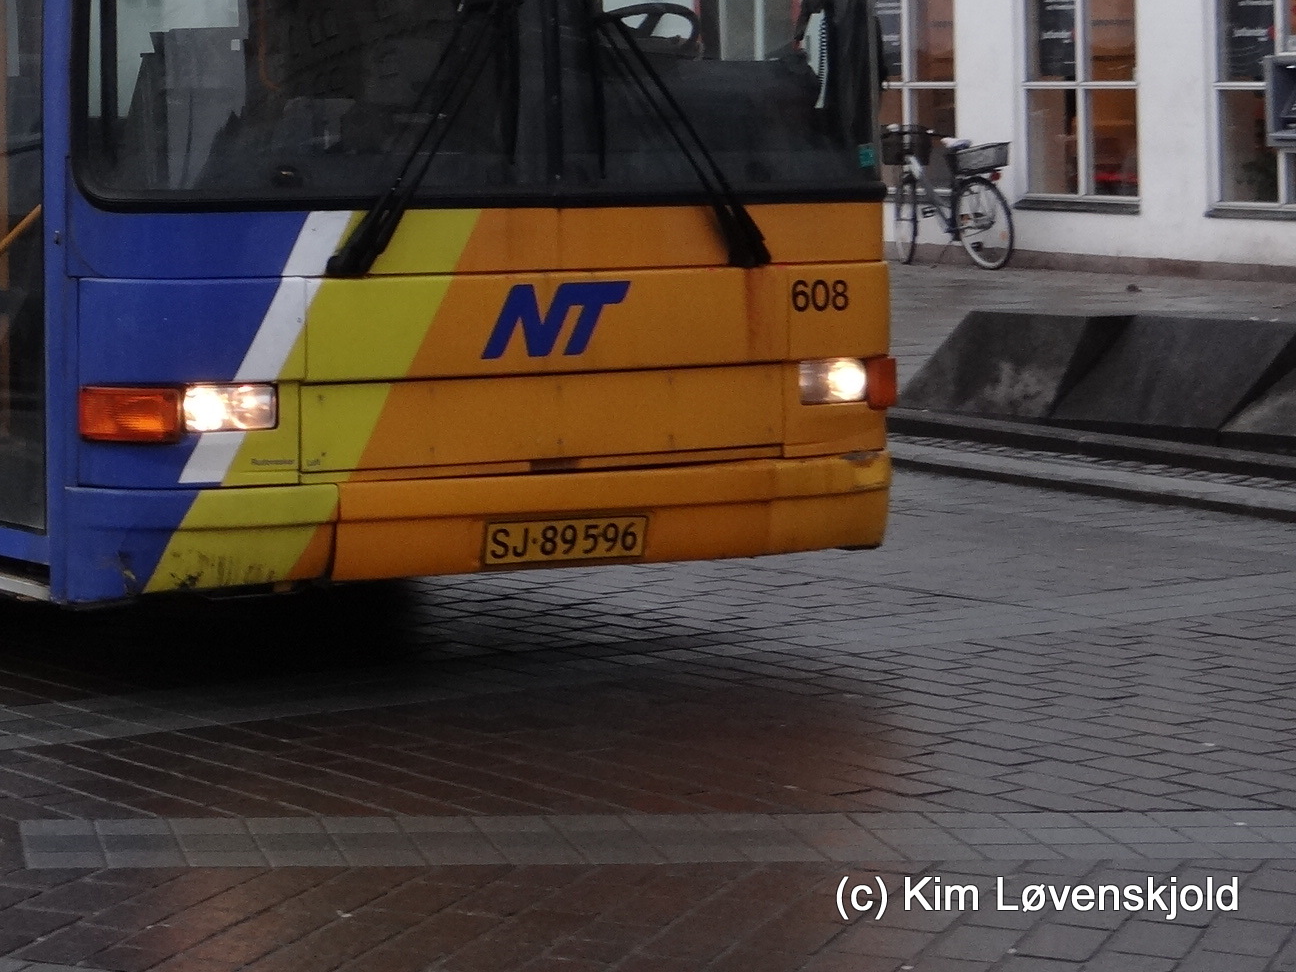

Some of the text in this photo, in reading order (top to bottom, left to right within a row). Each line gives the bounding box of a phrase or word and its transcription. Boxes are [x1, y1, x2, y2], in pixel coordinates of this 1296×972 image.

[791, 279, 850, 313] 608
[480, 280, 631, 360] NT
[491, 527, 529, 559] SJ
